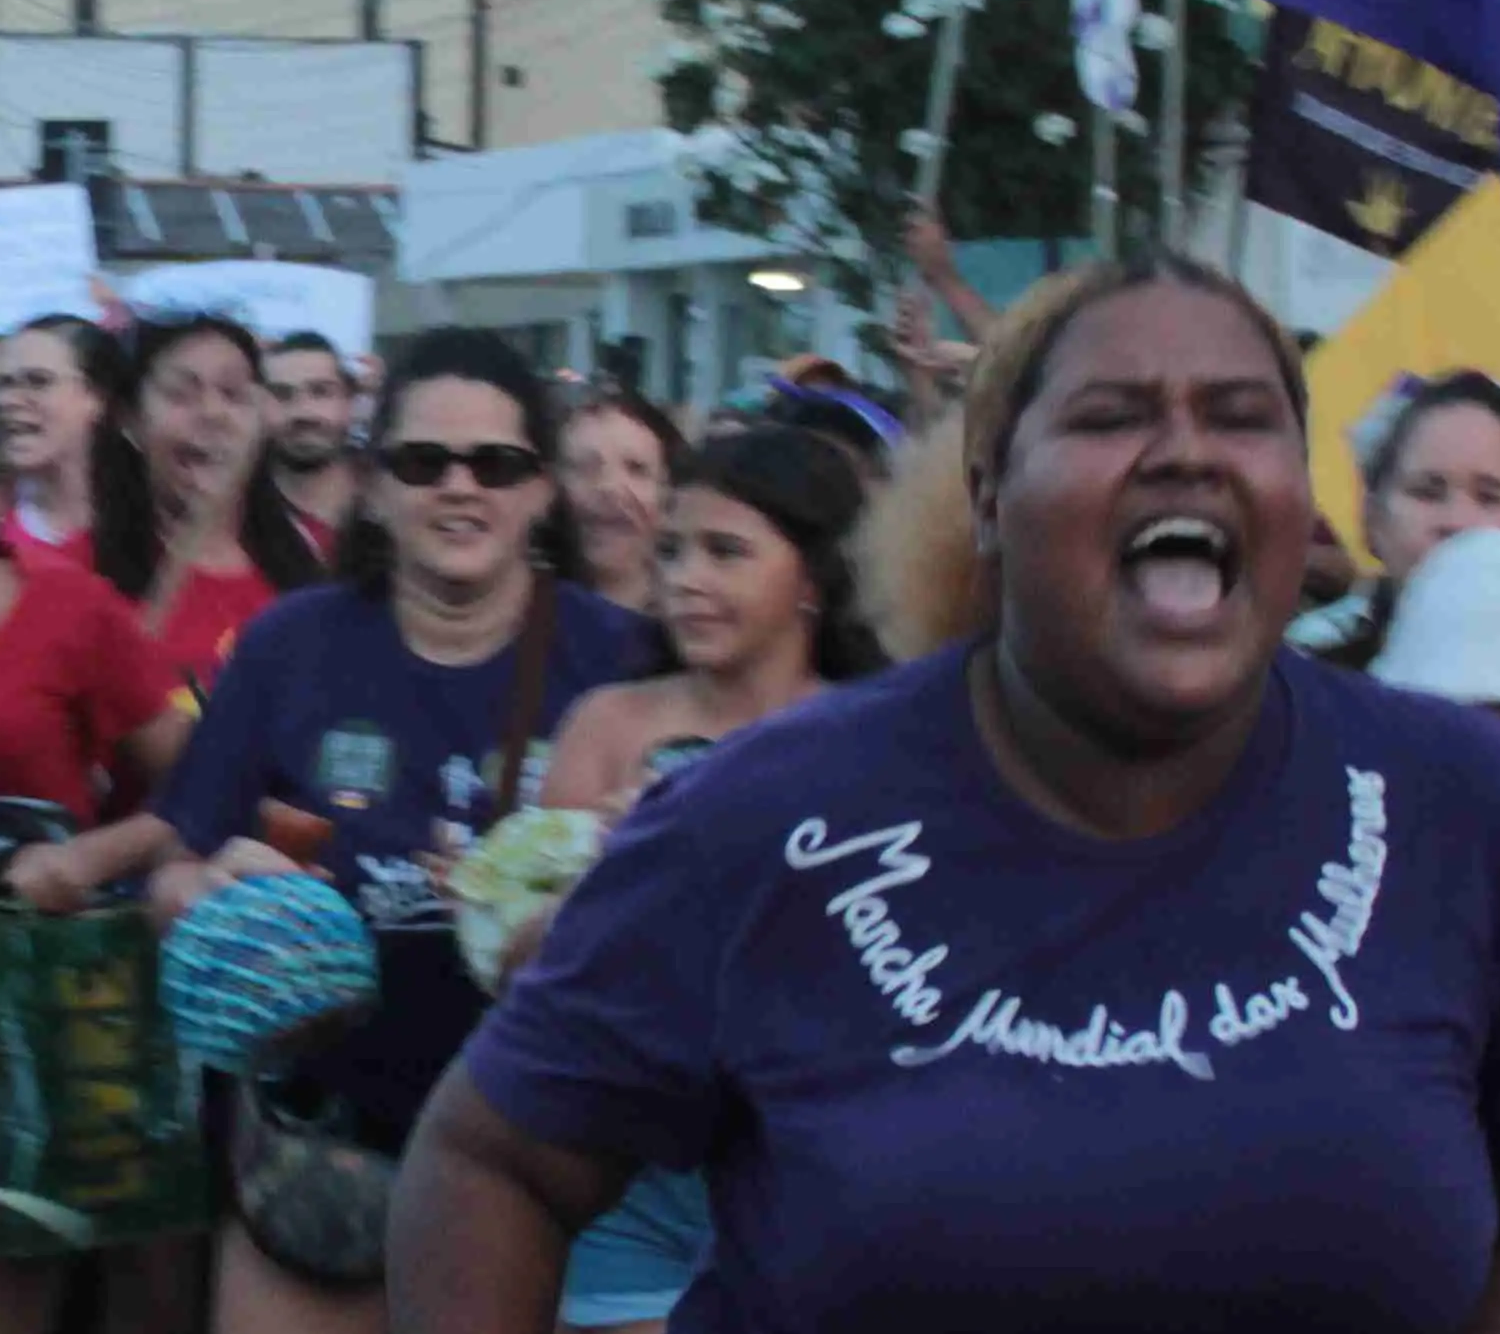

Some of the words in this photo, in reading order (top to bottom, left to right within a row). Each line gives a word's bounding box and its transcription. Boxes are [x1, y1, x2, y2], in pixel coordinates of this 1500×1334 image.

[785, 817, 950, 1025] Marcha
[890, 989, 1214, 1080] Mundial
[1208, 975, 1309, 1046] das
[1288, 763, 1388, 1030] Mulheres
